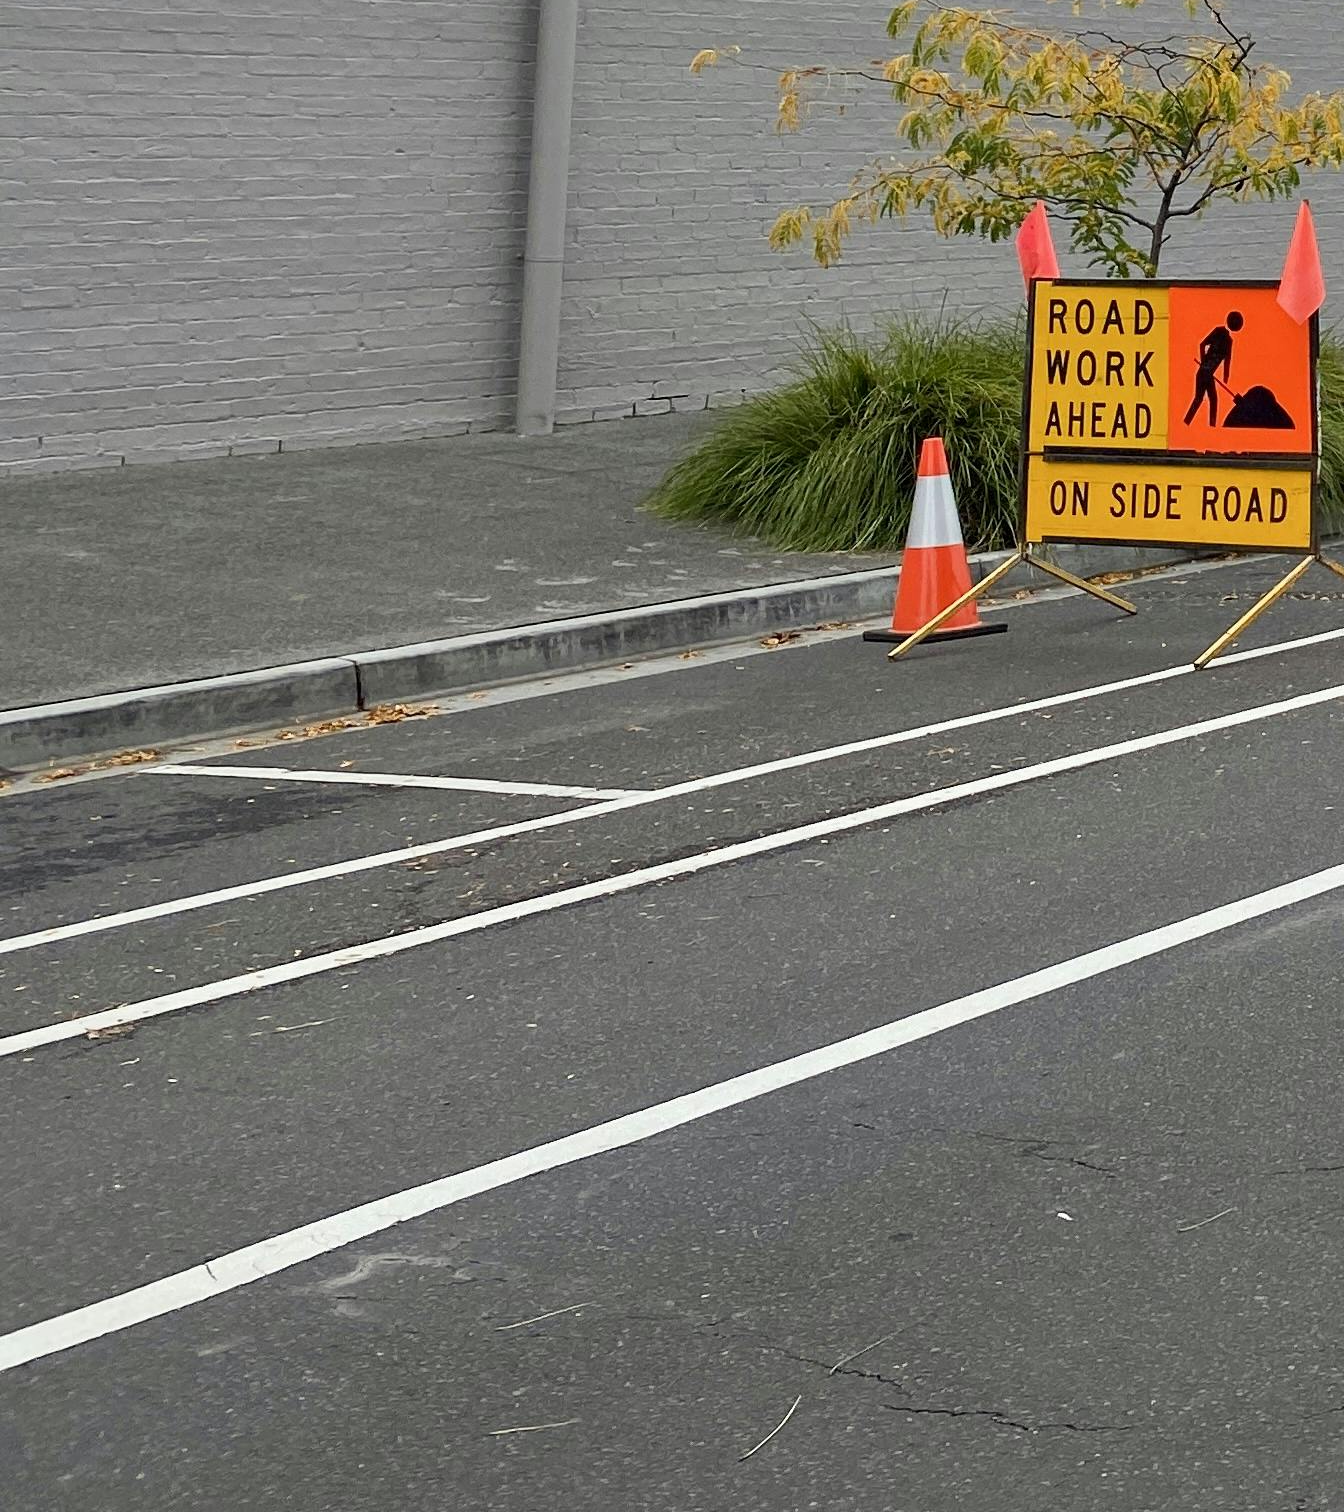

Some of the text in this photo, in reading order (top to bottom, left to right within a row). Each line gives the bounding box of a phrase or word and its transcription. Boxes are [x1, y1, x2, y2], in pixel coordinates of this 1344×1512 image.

[1048, 299, 1155, 336] ROAD
[1047, 351, 1154, 387] WORK
[1045, 402, 1152, 439] AHEAD
[1050, 480, 1289, 524] ON SIDE ROAD
